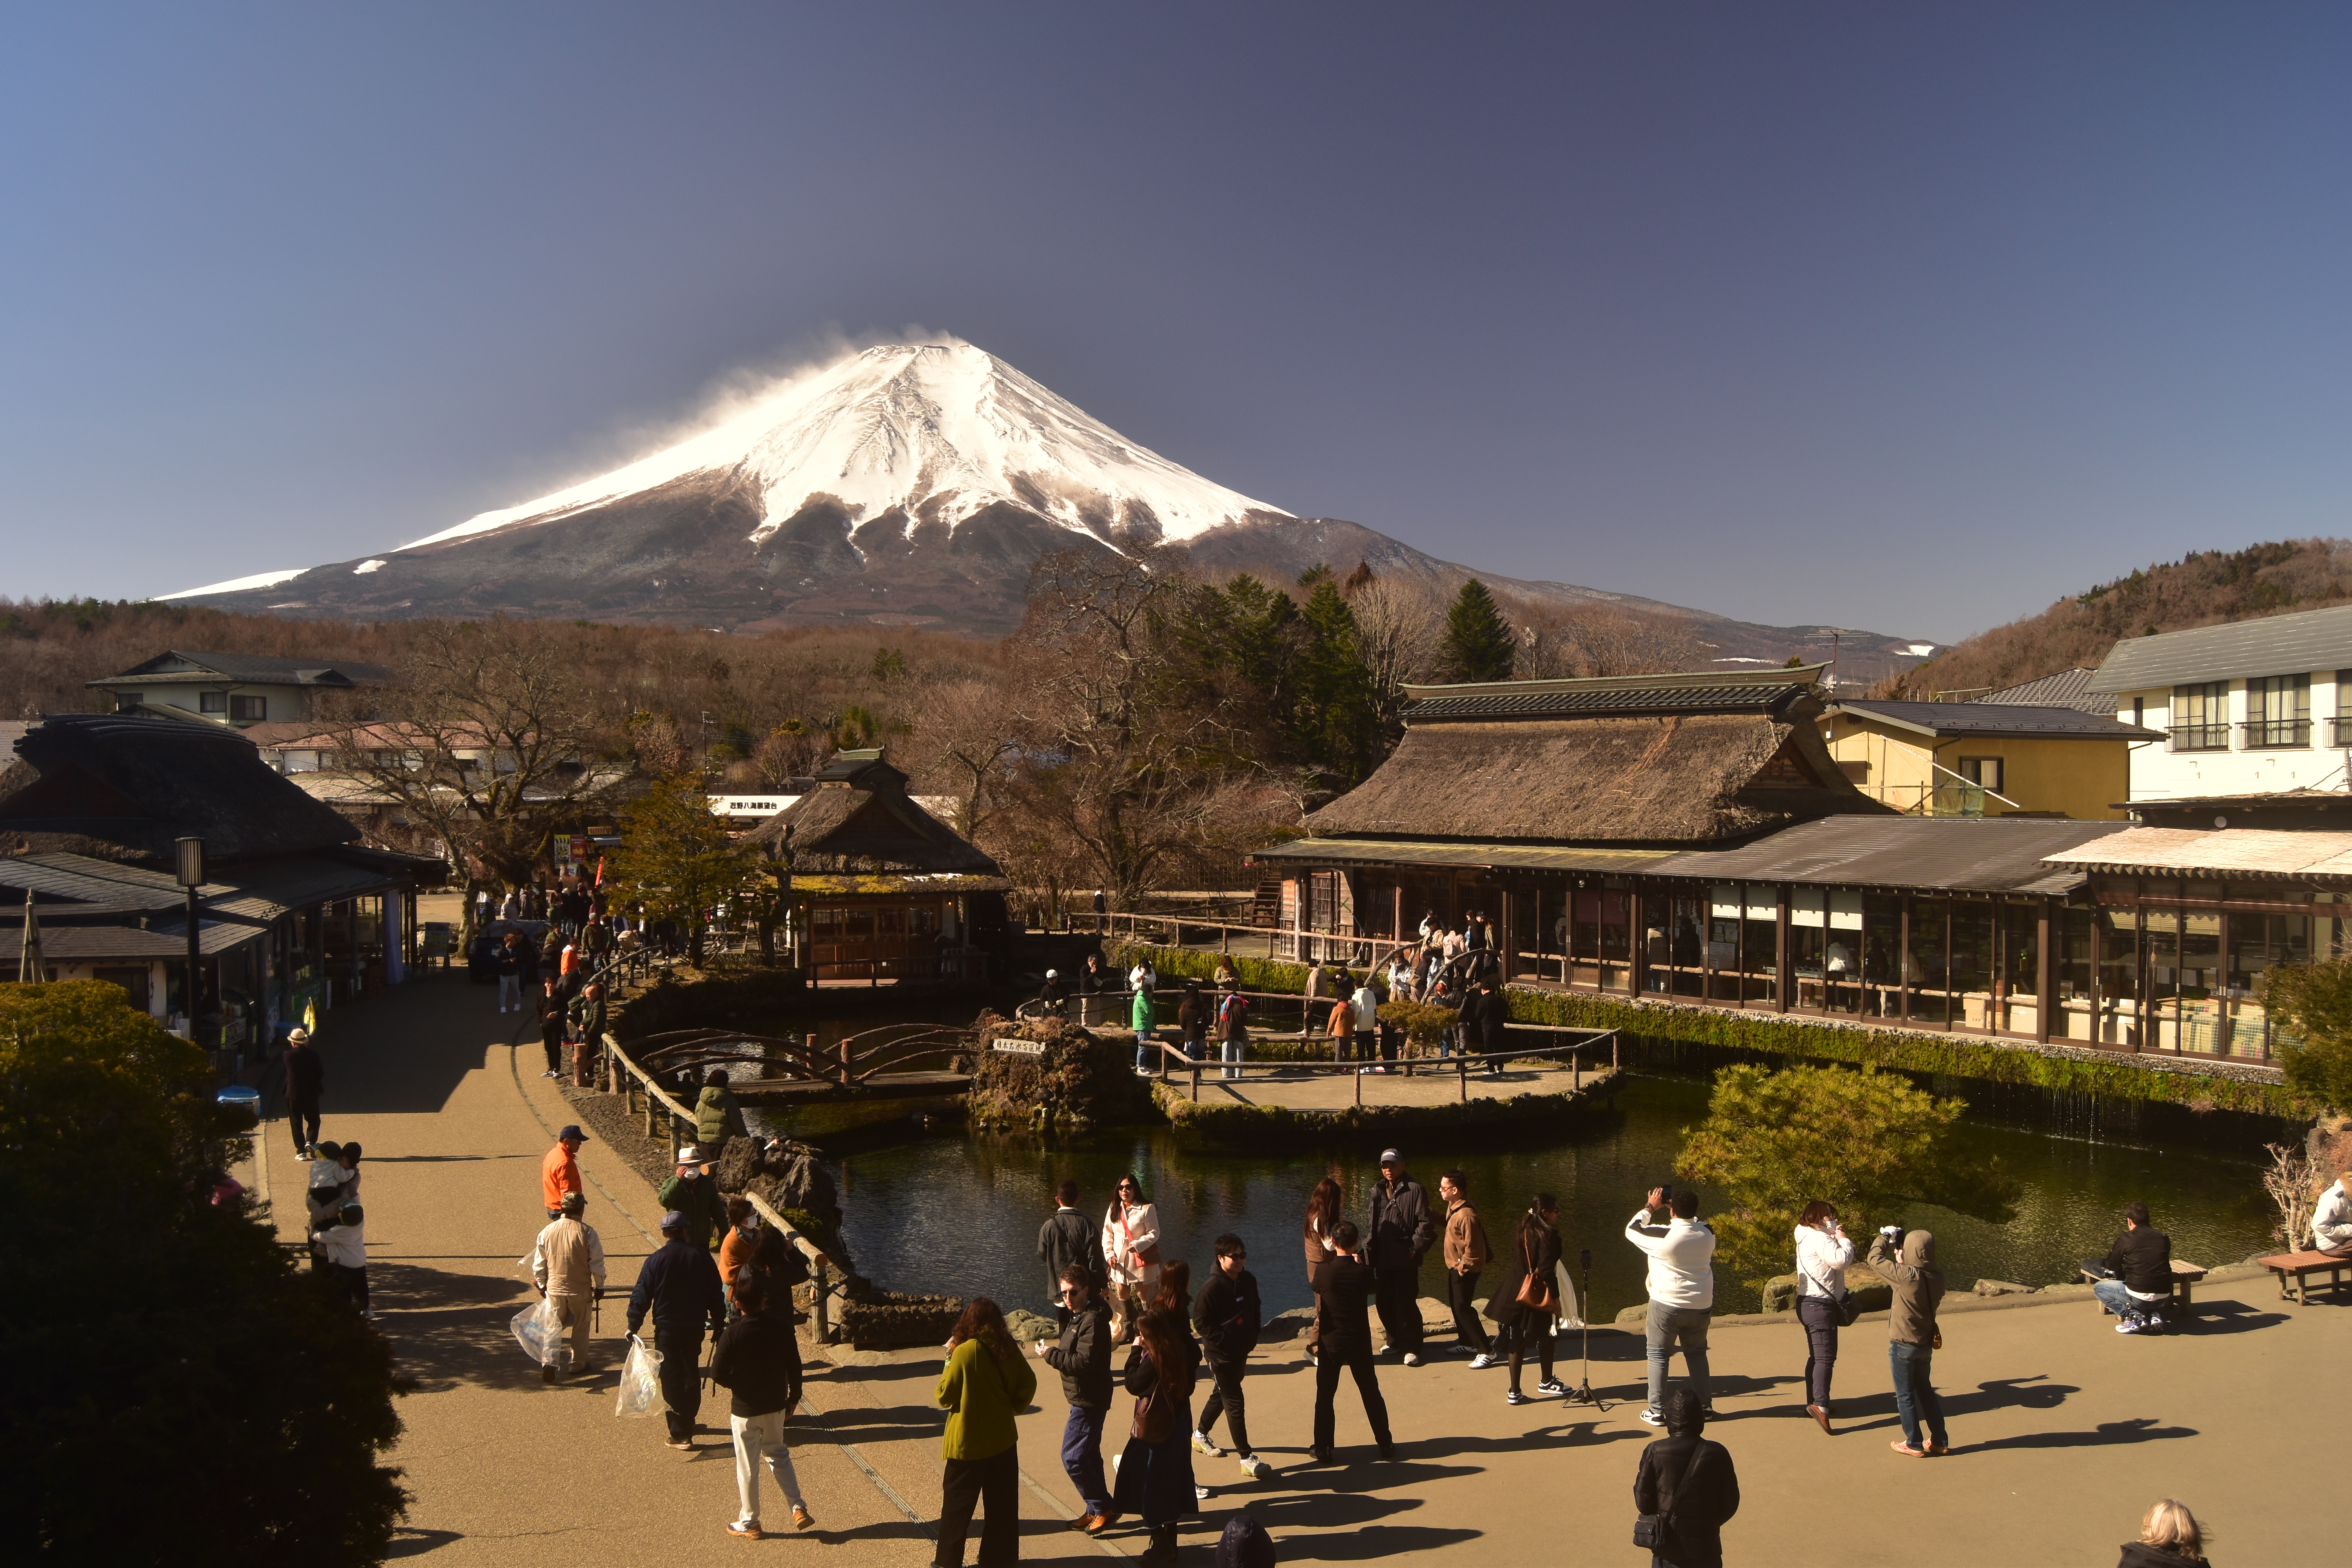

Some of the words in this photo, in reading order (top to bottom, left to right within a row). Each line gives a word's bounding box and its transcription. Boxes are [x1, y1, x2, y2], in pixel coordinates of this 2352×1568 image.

[997, 1041, 1041, 1052] 日本名水百選地
